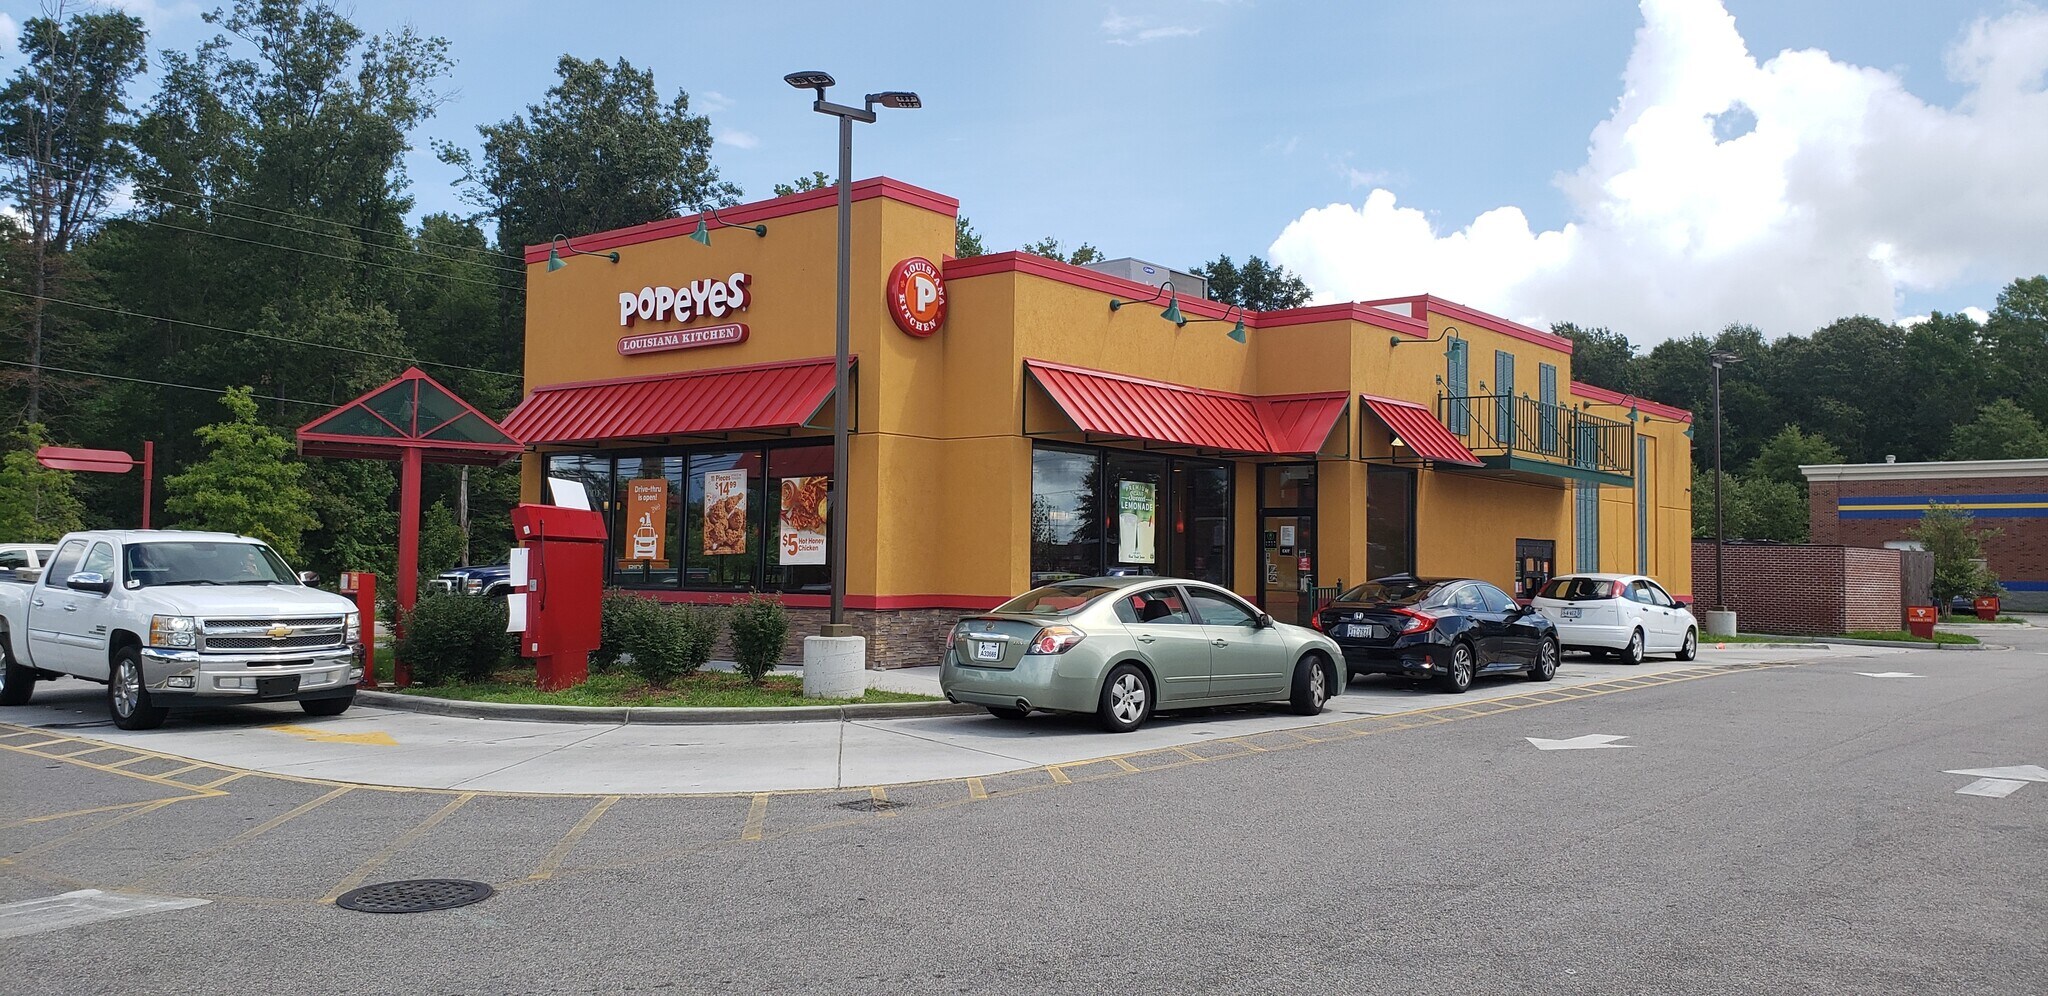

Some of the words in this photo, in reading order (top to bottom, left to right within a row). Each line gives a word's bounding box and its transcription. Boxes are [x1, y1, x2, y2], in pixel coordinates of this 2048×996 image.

[904, 263, 945, 305] LOUISIANA
[916, 276, 937, 312] P
[899, 293, 936, 331] KITCHEN
[623, 335, 679, 350] LOUISIANA
[682, 328, 735, 343] KITCHEN
[634, 485, 662, 493] Drive-thru
[643, 494, 658, 502] open!
[1121, 501, 1153, 511] LEMONADE
[782, 533, 798, 556] $5
[809, 537, 824, 545] Honey
